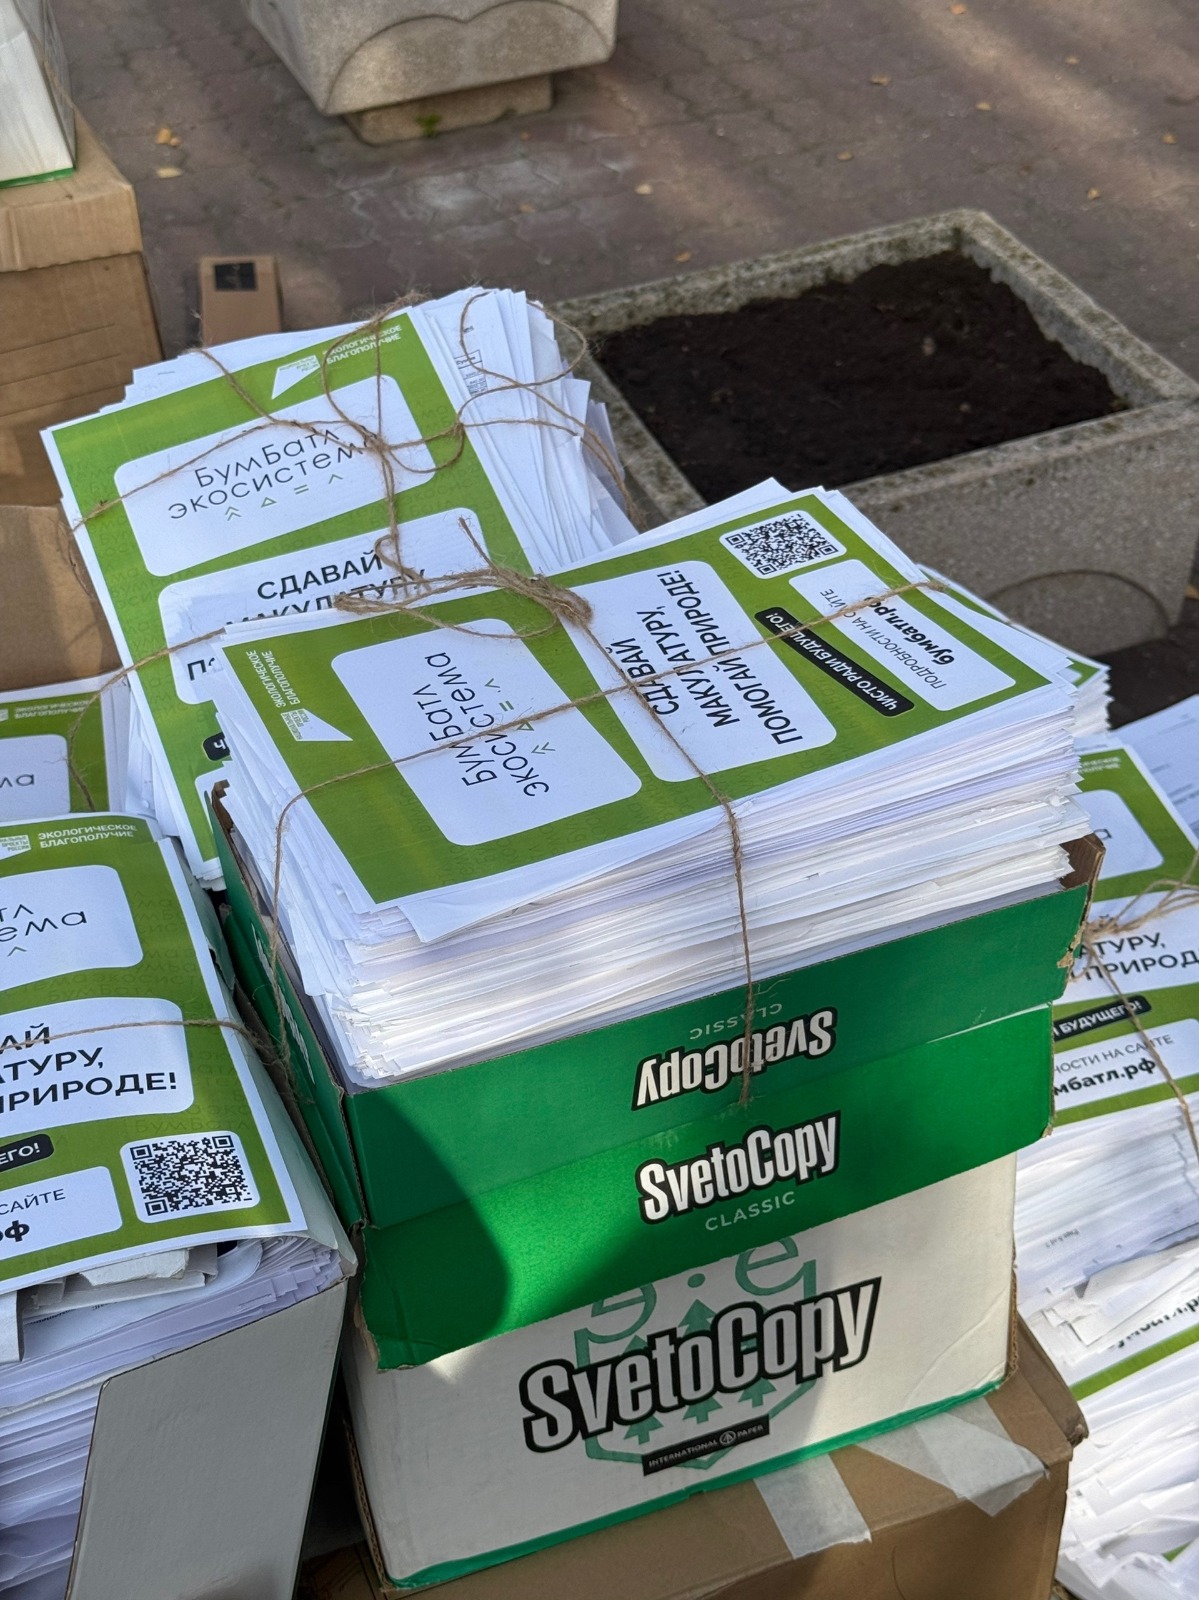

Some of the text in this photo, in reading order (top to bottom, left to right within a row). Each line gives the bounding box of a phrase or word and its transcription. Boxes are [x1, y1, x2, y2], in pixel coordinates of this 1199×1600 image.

[168, 427, 378, 519] экосистем
[194, 429, 340, 488] БумБатл
[256, 549, 383, 600] СДАВАЙ
[851, 616, 865, 630] НА
[246, 650, 287, 708] ЭКОЛОГИЧЕСКОЕ
[261, 650, 301, 706] БЛАГОПОЛУЧИЕ
[657, 570, 803, 745] ПОМОГАЙ ПРИРОДЕ!
[825, 658, 858, 683] РАДИ
[865, 625, 948, 690] ПОДРОБНОСТИ
[856, 681, 897, 711] ЧИСТО
[412, 684, 498, 787] БумБатл
[38, 824, 138, 840] ЭКОЛОГИЧЕСКОЕ
[40, 830, 134, 849] БЛАГОПОЛУЧИЕ
[0, 1047, 104, 1084] ТУРУ,
[1102, 1048, 1124, 1062] НА
[0, 1072, 177, 1113] РИРОДЕ!
[636, 1110, 841, 1225] SvetoCopy
[0, 1220, 30, 1242] ф
[704, 1190, 797, 1233] CLASSIC
[518, 1276, 882, 1453] SvetoCopy
[648, 1424, 765, 1468] INTERNATIONAL PAPER
